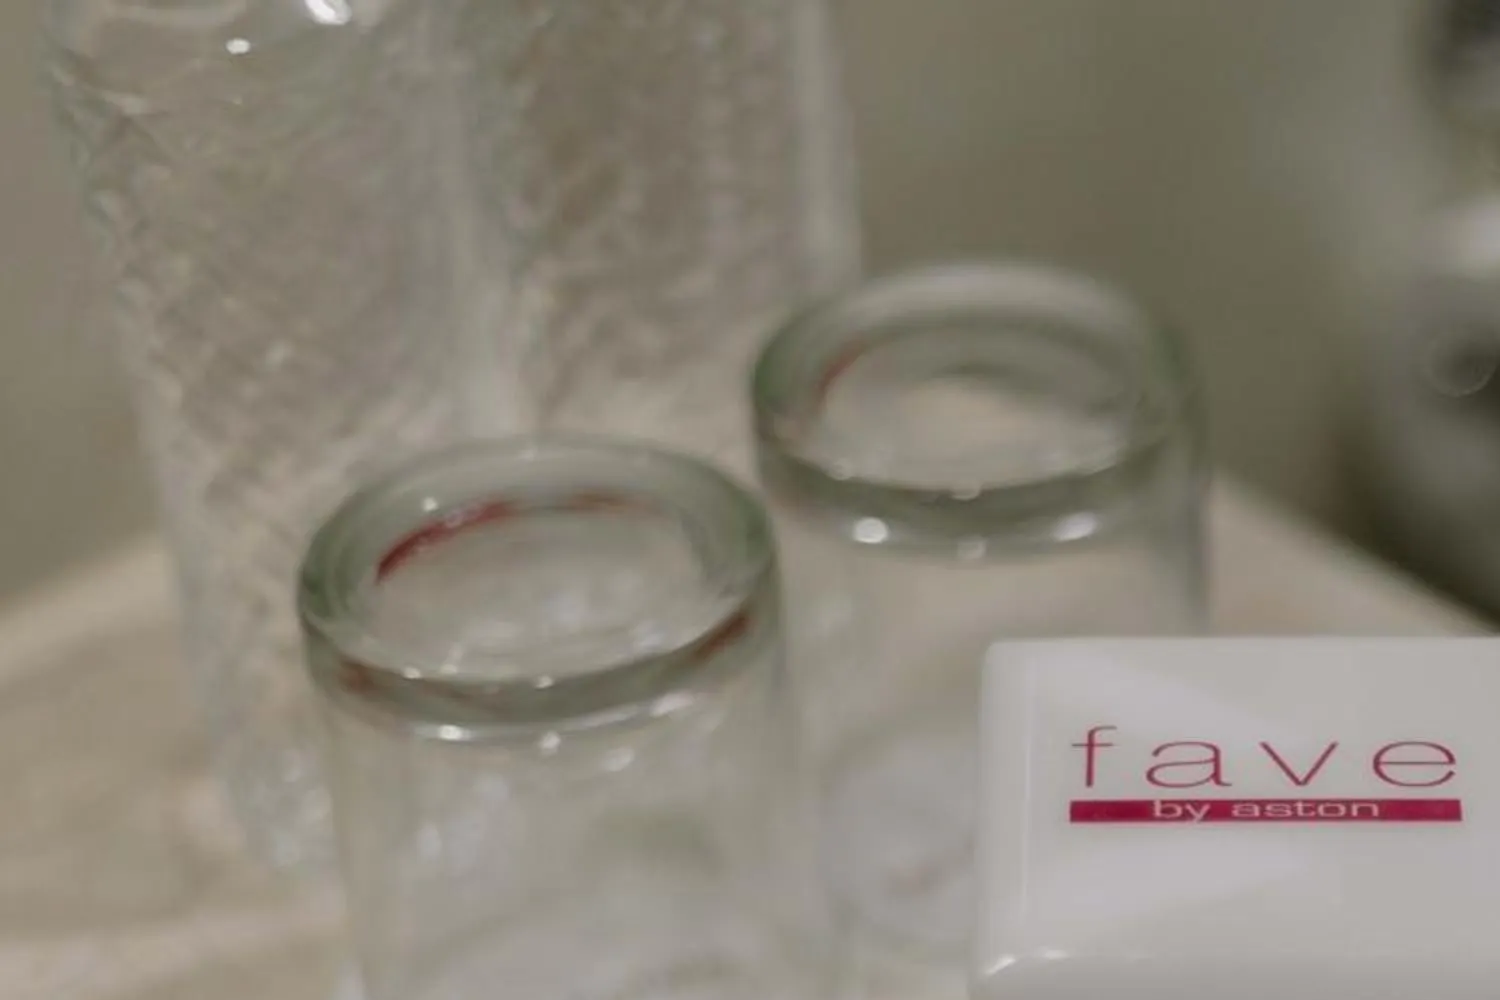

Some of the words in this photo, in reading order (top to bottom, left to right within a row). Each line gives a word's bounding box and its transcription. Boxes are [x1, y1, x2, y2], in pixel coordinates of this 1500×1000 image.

[1070, 725, 1458, 788] fave
[1152, 799, 1211, 823] by
[1231, 800, 1380, 819] aston
